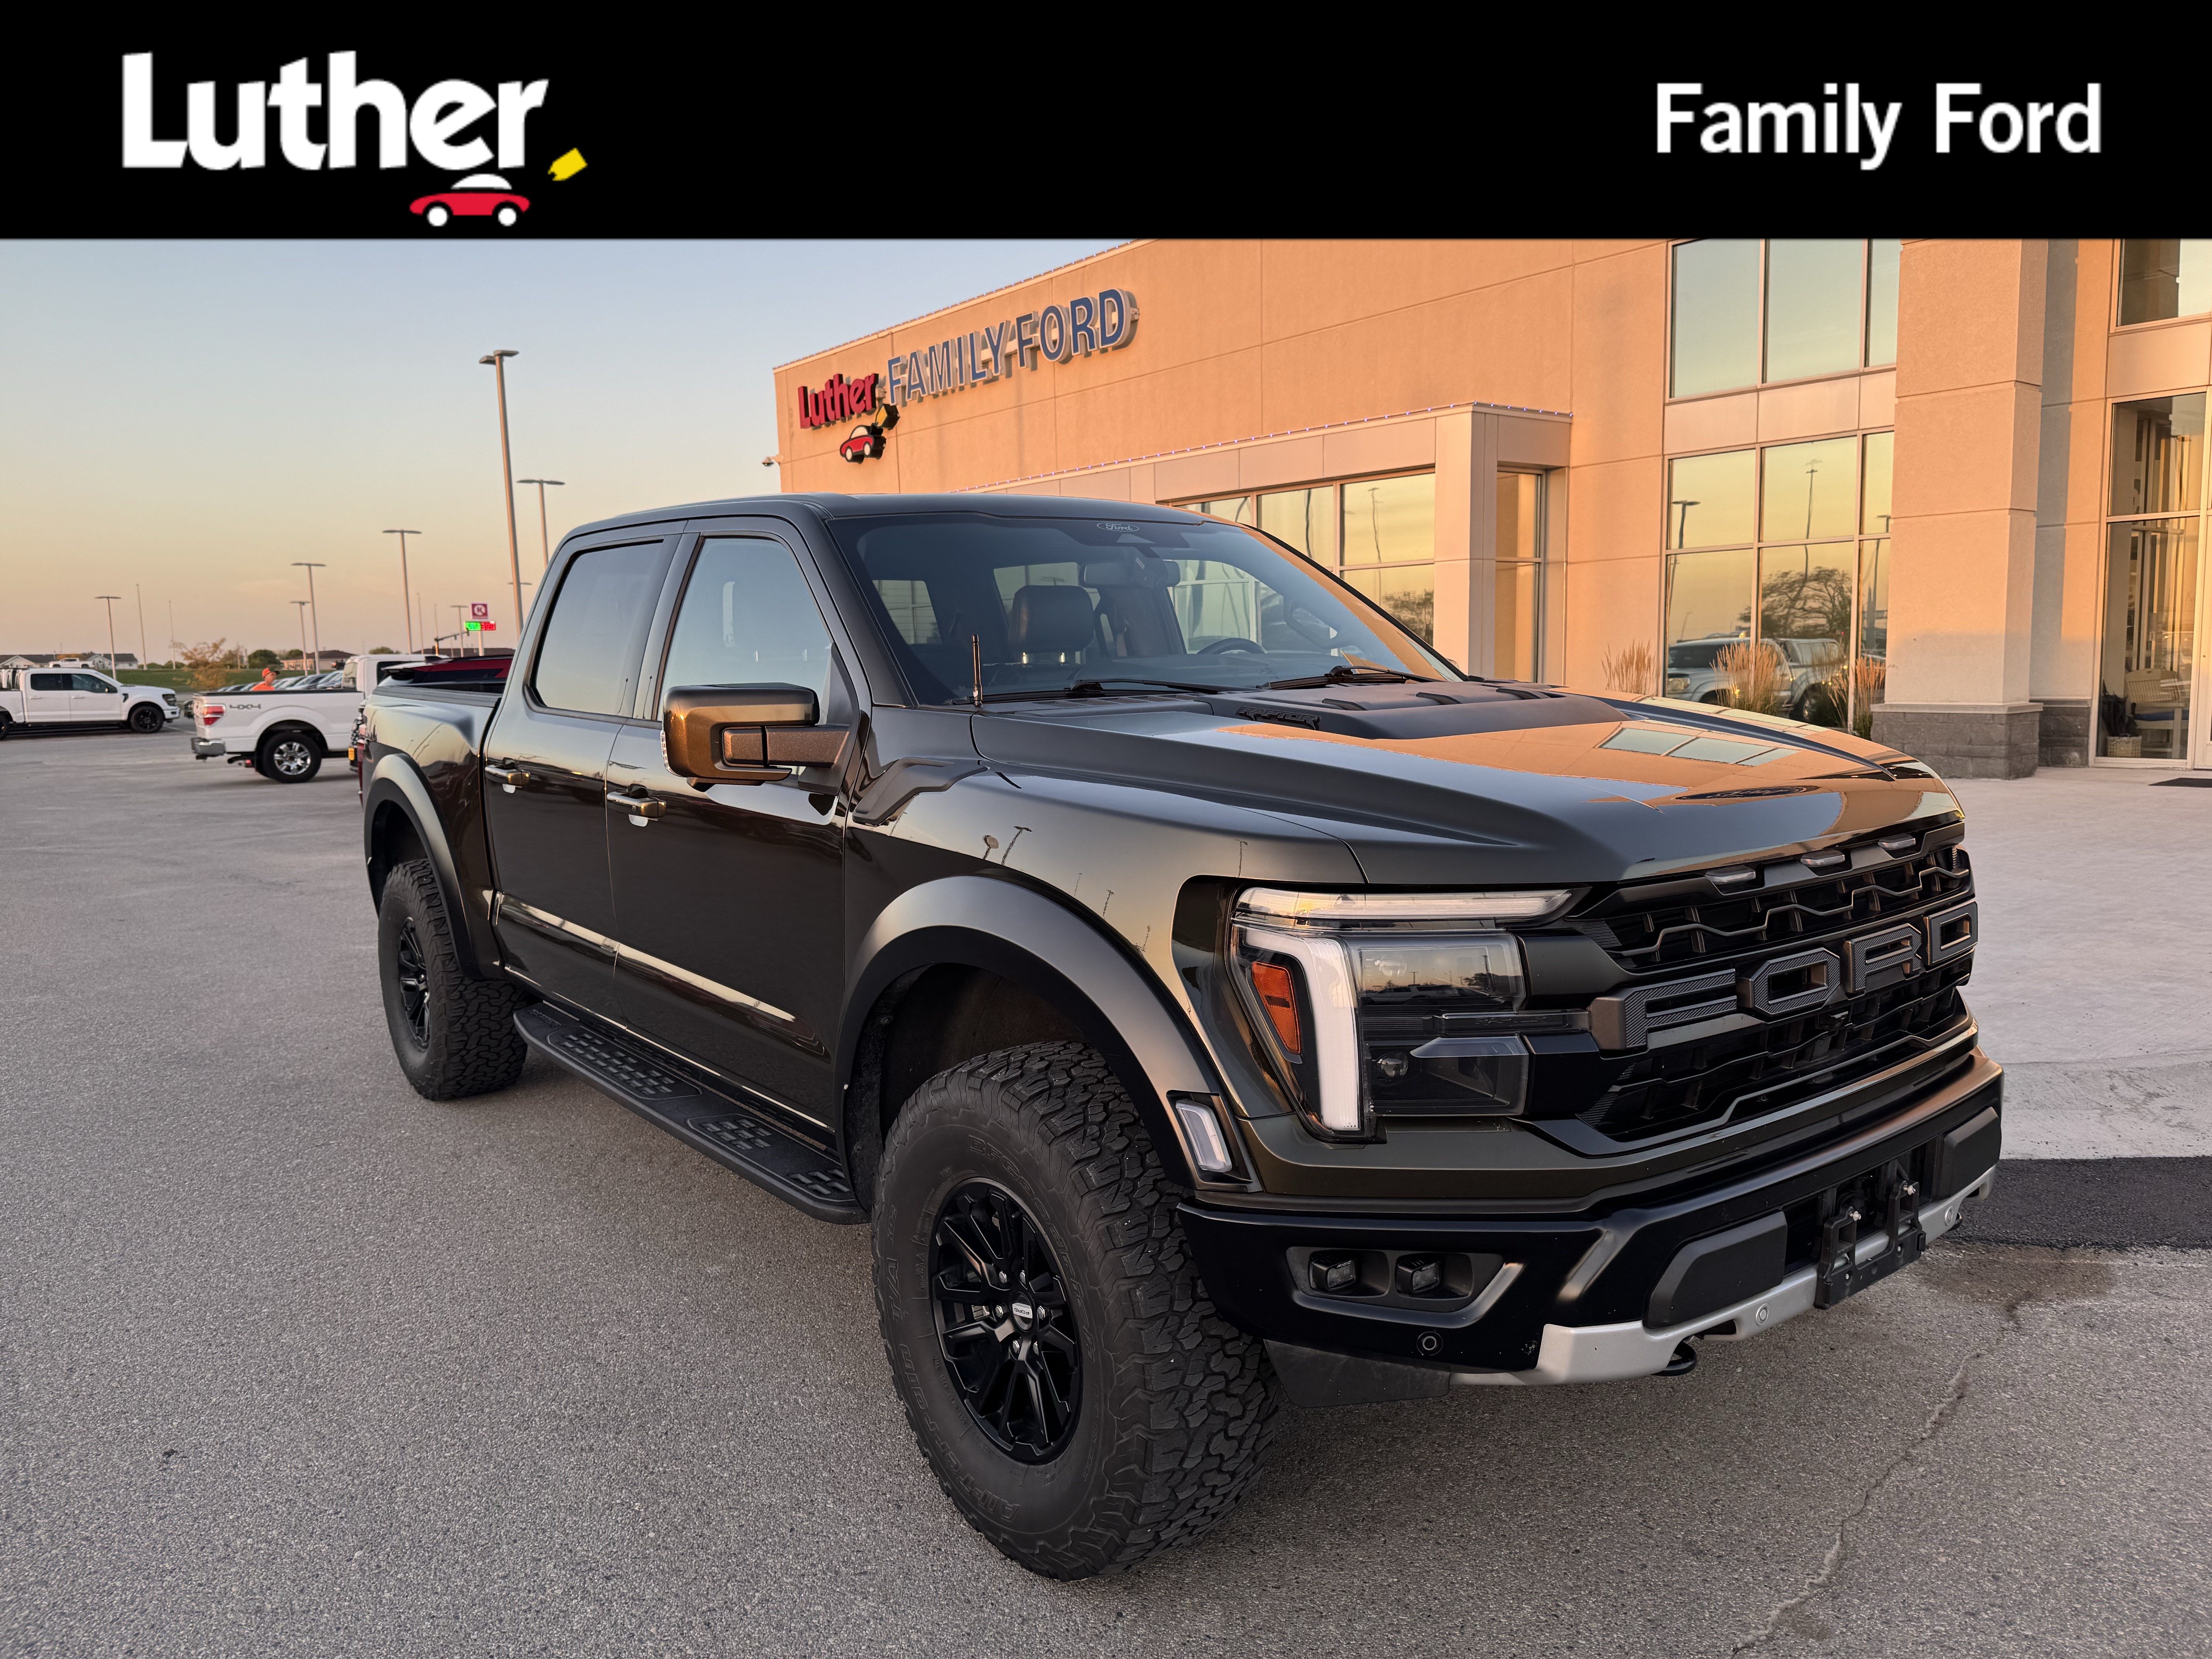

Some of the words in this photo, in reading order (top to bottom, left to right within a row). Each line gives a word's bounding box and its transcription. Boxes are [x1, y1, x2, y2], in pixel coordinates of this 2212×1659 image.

[887, 320, 1008, 405] FAMILY
[1016, 288, 1130, 369] FORD
[798, 373, 878, 429] Luther
[1237, 706, 1321, 731] RAPTOR
[1590, 900, 1978, 1055] FORD
